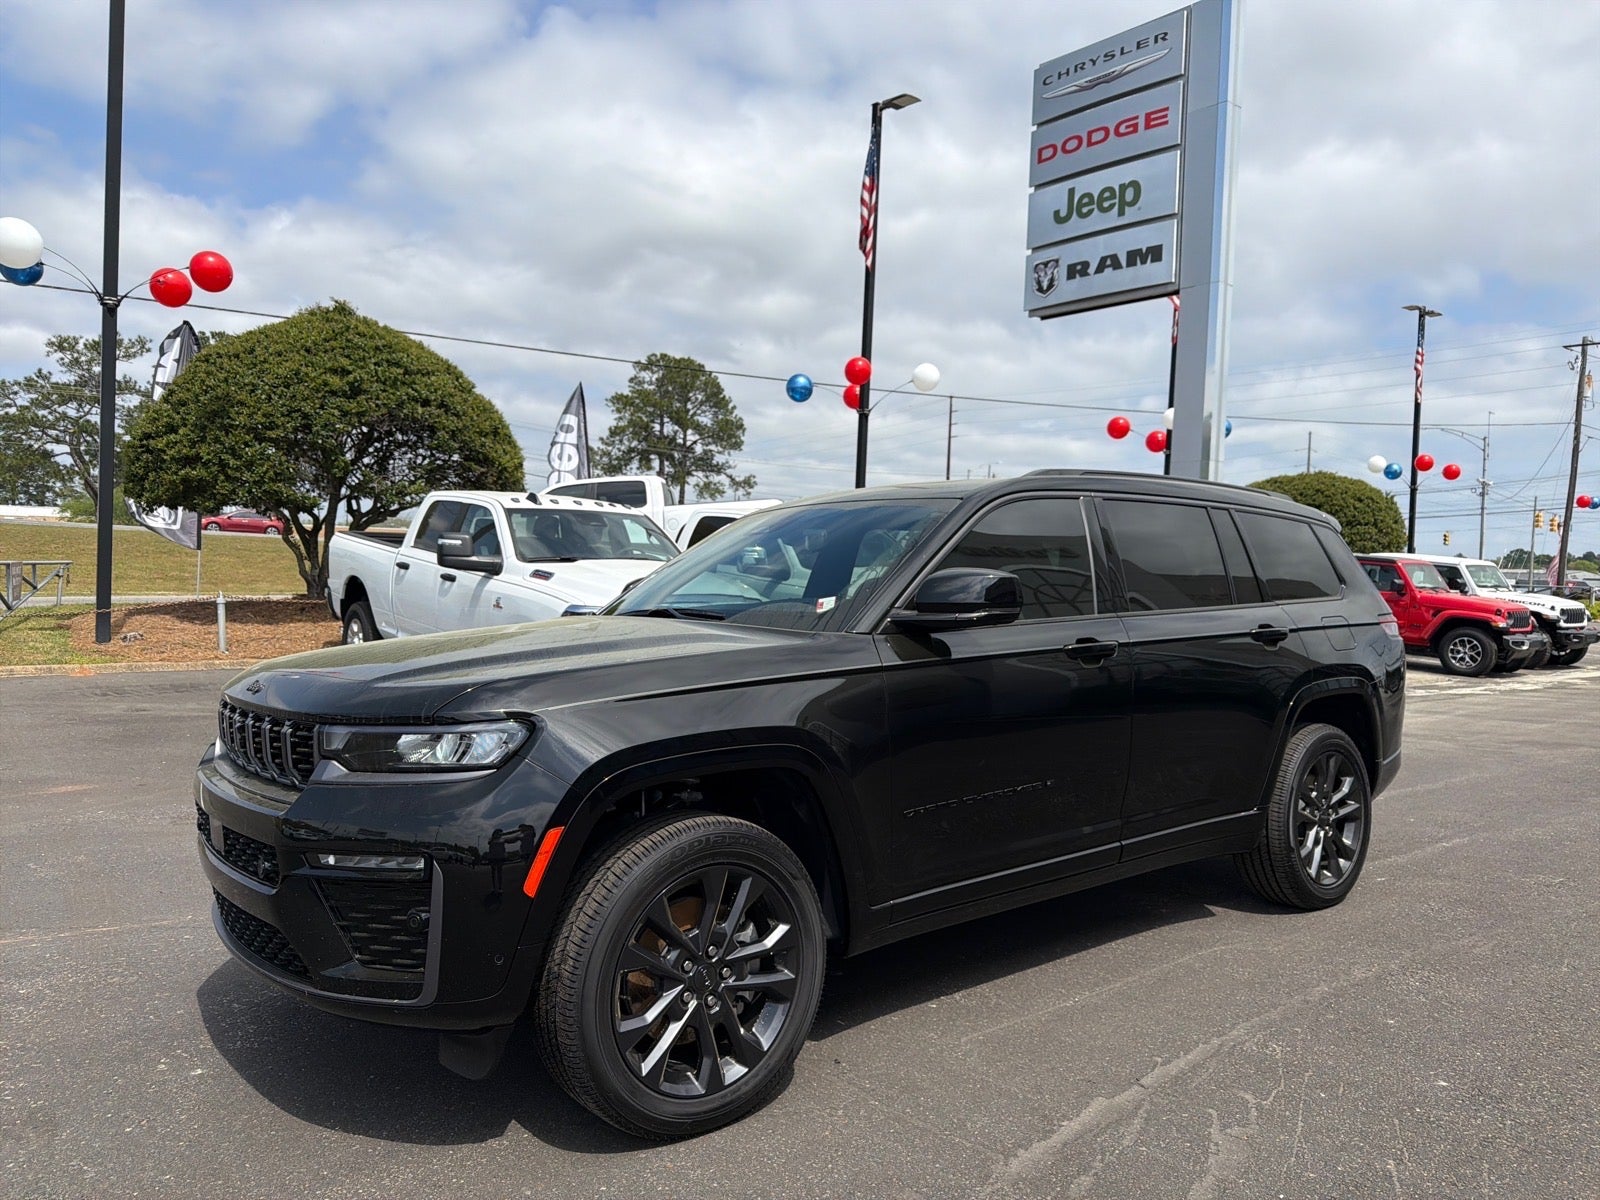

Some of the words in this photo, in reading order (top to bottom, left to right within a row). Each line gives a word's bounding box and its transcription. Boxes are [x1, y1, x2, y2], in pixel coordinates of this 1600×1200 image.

[1042, 32, 1169, 86] CHRYSLER
[1037, 106, 1170, 165] DODGE
[1053, 179, 1142, 225] Jeep
[1066, 244, 1163, 281] RAM
